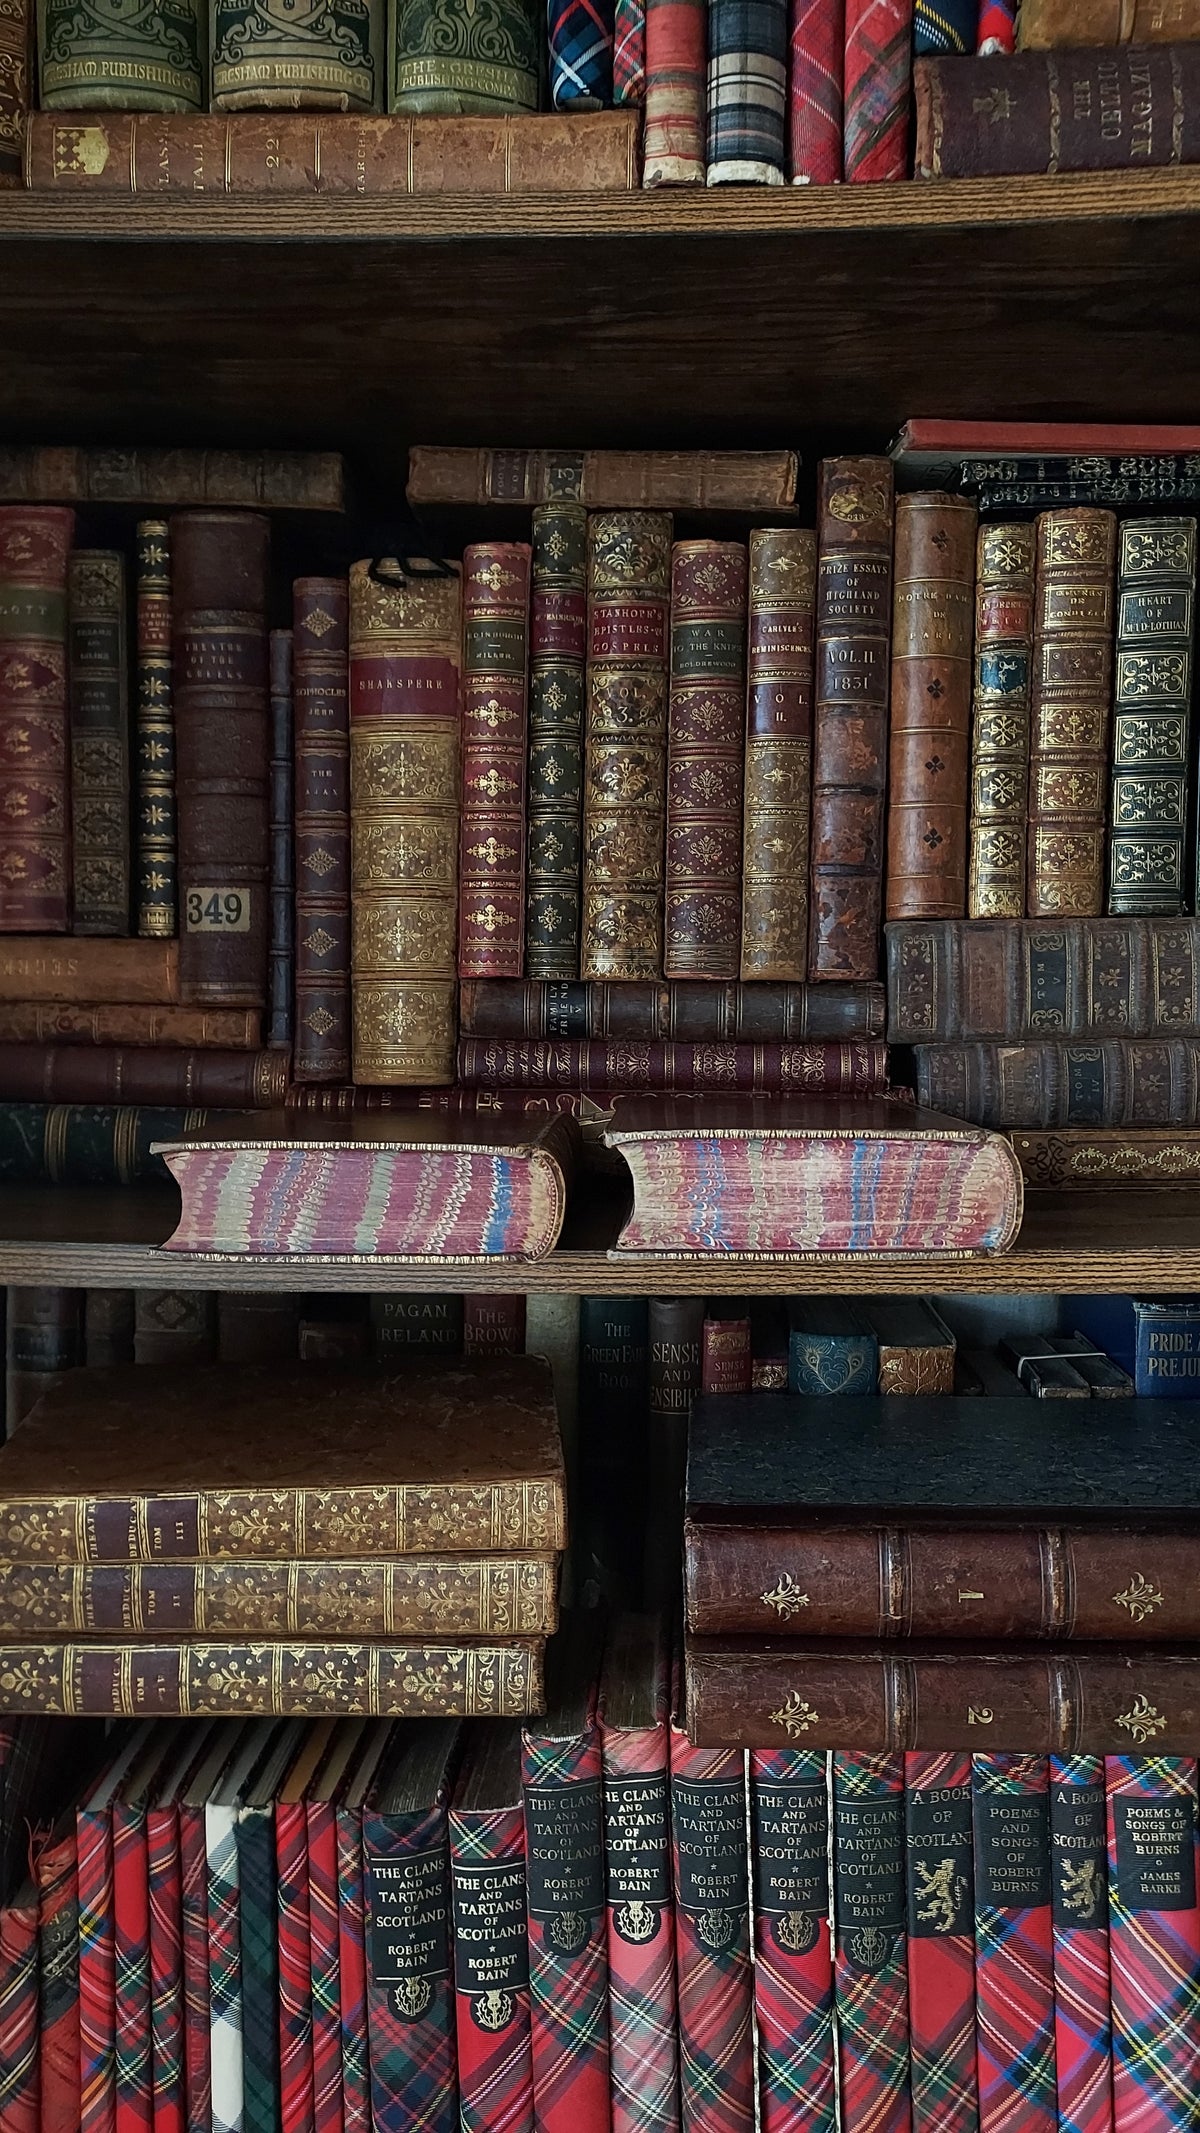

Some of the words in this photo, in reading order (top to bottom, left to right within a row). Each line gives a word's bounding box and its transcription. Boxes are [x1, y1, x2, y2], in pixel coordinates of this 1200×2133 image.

[102, 61, 180, 85] PUBLISHING
[274, 64, 353, 85] PUBLISHING
[401, 60, 435, 75] THE
[450, 62, 528, 84] GRESHA
[1072, 80, 1091, 120] THE
[1126, 48, 1153, 158] MAGAZI
[820, 564, 850, 575] PRIZE
[853, 564, 888, 575] ESSAYS
[846, 577, 860, 587] OF
[826, 591, 880, 601] HIGHLAND
[946, 593, 971, 603] DAM
[1138, 596, 1173, 606] HEART
[828, 604, 876, 615] SOCIETY
[1146, 609, 1163, 619] OF
[691, 629, 726, 638] WAR
[593, 642, 659, 653] GOSPELS
[690, 643, 708, 652] THE
[679, 660, 737, 670] BOLDREWOOD
[359, 679, 444, 691] SHAKSPERE
[754, 693, 809, 705] VOL.
[188, 893, 243, 925] 349
[1036, 962, 1046, 999] TOM
[549, 984, 558, 1031] FAMILY
[560, 982, 569, 1035] FRIEND
[384, 1303, 448, 1318] PAGAN
[476, 1308, 506, 1324] THE
[376, 1327, 458, 1343] IRELAND
[604, 1322, 631, 1337] THE
[1148, 1333, 1193, 1352] PRIDE
[652, 1341, 699, 1365] SENSE
[662, 1369, 691, 1382] AND
[86, 1500, 99, 1559] THEATR
[175, 1521, 184, 1541] III
[153, 1527, 163, 1551] TOM
[172, 1594, 181, 1608] II
[958, 1588, 985, 1604] 1
[147, 1590, 156, 1616] TOM
[136, 1676, 145, 1703] TOM
[967, 1706, 994, 1725] 2
[605, 1791, 619, 1803] HE
[622, 1786, 666, 1802] CLANS
[675, 1790, 700, 1805] THE
[704, 1791, 745, 1807] CLANS
[757, 1794, 784, 1808] THE
[911, 1790, 927, 1806] A
[929, 1787, 972, 1805] BOOK
[1056, 1791, 1069, 1804] A
[529, 1798, 556, 1811] THE
[559, 1792, 602, 1810] CLANS
[618, 1803, 643, 1813] AND
[554, 1811, 579, 1821] AND
[699, 1809, 724, 1818] AND
[781, 1811, 807, 1820] AND
[862, 1810, 899, 1826] CLAN
[932, 1809, 953, 1824] OF
[990, 1807, 1041, 1819] POEMS
[1126, 1807, 1171, 1819] POEMS
[1174, 1808, 1185, 1819] &
[533, 1818, 598, 1836] TARTANS
[679, 1816, 744, 1832] TARTANS
[761, 1819, 826, 1835] TARTANS
[1074, 1814, 1093, 1827] OF
[1125, 1819, 1166, 1831] SONGS
[1171, 1819, 1188, 1830] OF
[624, 1828, 640, 1837] OF
[855, 1827, 881, 1837] AND
[1001, 1823, 1030, 1834] AND
[559, 1837, 575, 1847] OF
[704, 1834, 720, 1844] OF
[786, 1836, 802, 1846] OF
[991, 1836, 1040, 1848] SONGS
[1131, 1831, 1184, 1842] ROBERT
[605, 1837, 668, 1852] COTLAND
[679, 1841, 746, 1858] SCOTLAND
[836, 1836, 901, 1851] TARTANS
[1135, 1844, 1181, 1855] BURNS
[532, 1845, 601, 1861] SCOTLAND
[758, 1845, 828, 1860] SCOTLAND
[860, 1852, 876, 1862] OF
[1006, 1852, 1026, 1863] OF
[373, 1866, 401, 1880] THE
[404, 1858, 445, 1879] CLANS
[609, 1867, 660, 1879] ROBERT
[988, 1866, 1044, 1878] ROBERT
[454, 1876, 480, 1890] THE
[483, 1872, 526, 1891] CLANS
[543, 1875, 593, 1889] ROBERT
[690, 1873, 738, 1886] ROBERT
[769, 1876, 820, 1888] ROBERT
[1139, 1871, 1182, 1881] JAMES
[399, 1879, 423, 1889] AND
[618, 1880, 651, 1892] BAIN
[991, 1881, 1039, 1892] BURNS
[1140, 1883, 1182, 1894] BARKE
[378, 1883, 443, 1904] TARTANS
[478, 1891, 503, 1901] AND
[551, 1889, 585, 1902] BAIN
[698, 1887, 731, 1899] BAIN
[778, 1889, 812, 1901] BAIN
[843, 1892, 894, 1904] ROBERT
[404, 1905, 419, 1914] OF
[458, 1898, 523, 1916] TARTANS
[852, 1906, 886, 1917] BAIN
[376, 1908, 446, 1928] SCOTLAND
[483, 1916, 499, 1926] OF
[457, 1922, 527, 1941] SCOTLAND
[387, 1940, 437, 1956] ROBERT
[396, 1954, 428, 1969] BAIN
[467, 1953, 518, 1969] ROBERT
[476, 1967, 510, 1982] BAIN
